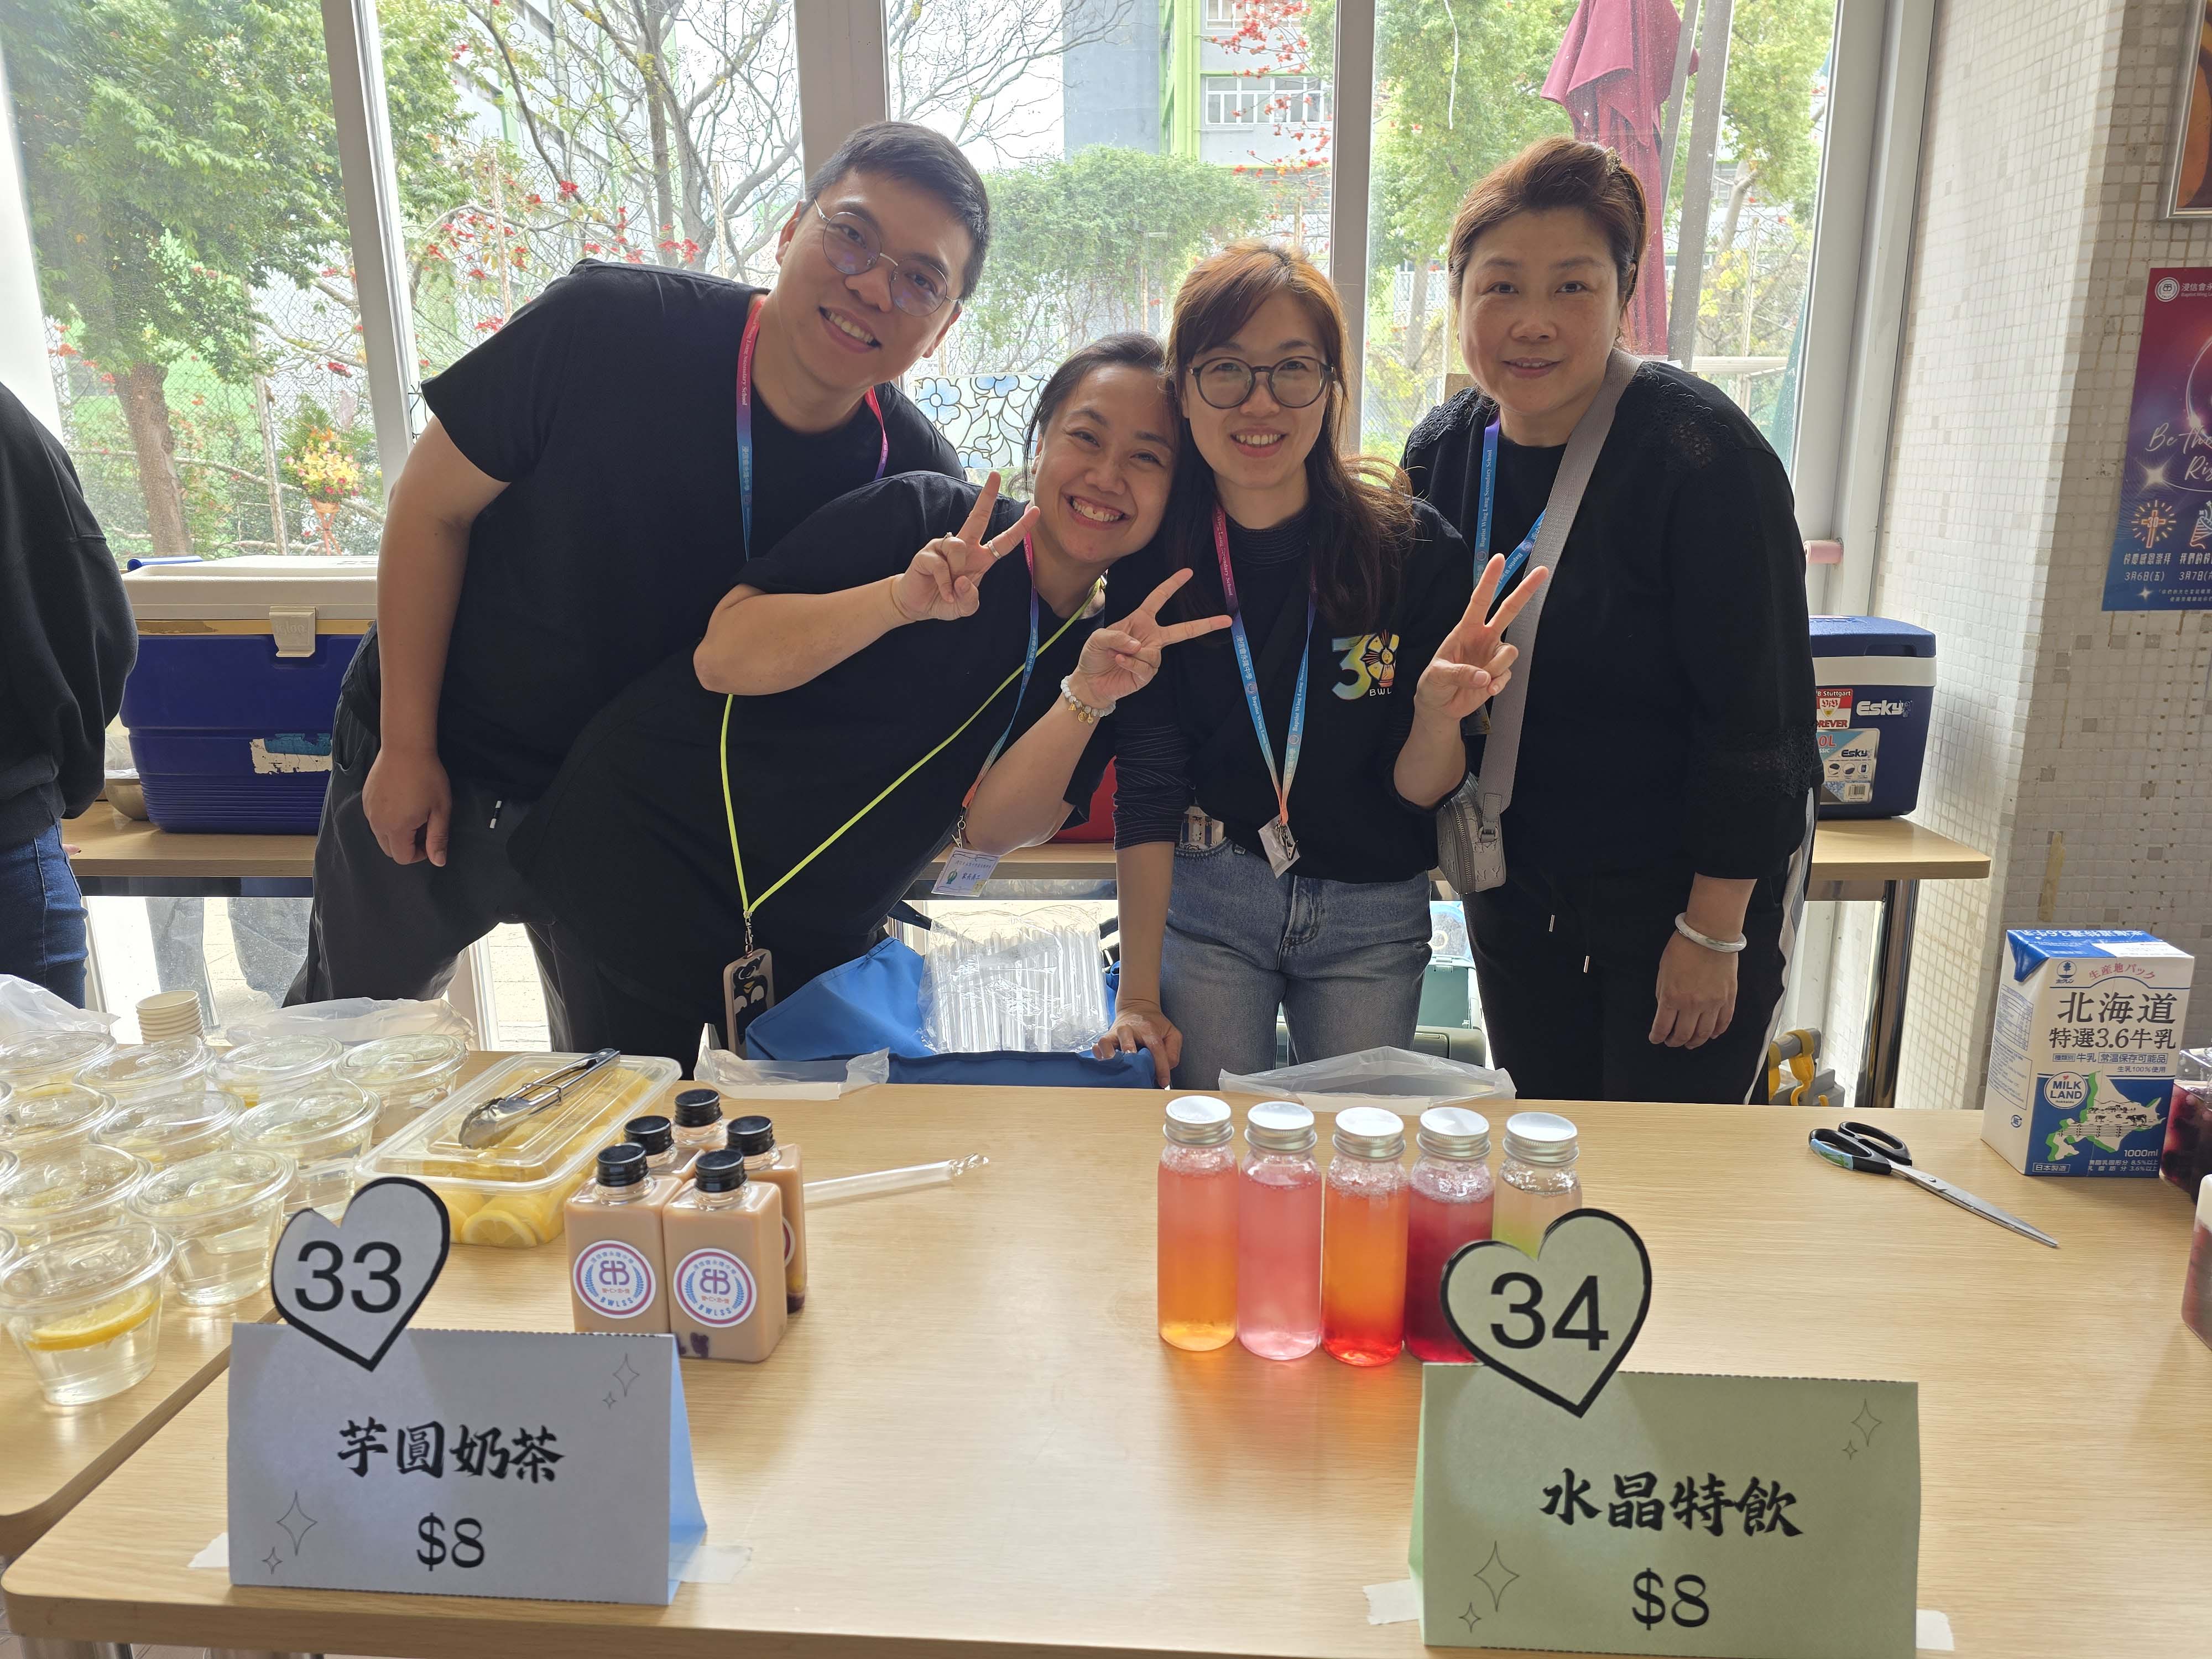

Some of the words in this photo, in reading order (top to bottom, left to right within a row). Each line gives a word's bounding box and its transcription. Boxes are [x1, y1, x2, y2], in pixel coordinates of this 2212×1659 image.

[2146, 422, 2178, 451] Be
[1508, 553, 1523, 569] Baptist
[2125, 571, 2164, 581] 3月6日(五)
[1369, 687, 1392, 697] BWL
[1856, 700, 1904, 716] Esky
[1841, 749, 1868, 758] Esky
[2089, 963, 2156, 980] 生産地パック
[2057, 992, 2177, 1024] 北海道
[2049, 1027, 2176, 1049] 特選3.6牛乳
[2077, 1053, 2096, 1062] 牛乳
[2100, 1053, 2166, 1063] 常温保存可能品
[2052, 1081, 2081, 1089] MILK
[2050, 1091, 2082, 1099] LAND
[2124, 1149, 2158, 1157] 1000ml
[294, 1240, 402, 1313] 33
[698, 1303, 732, 1316] BWLSS
[1490, 1272, 1609, 1352] 34
[337, 1416, 565, 1483] 芋圓奶茶
[1540, 1468, 1804, 1537] 水晶特飲
[416, 1512, 486, 1571] $8
[1632, 1567, 1710, 1630] $8
